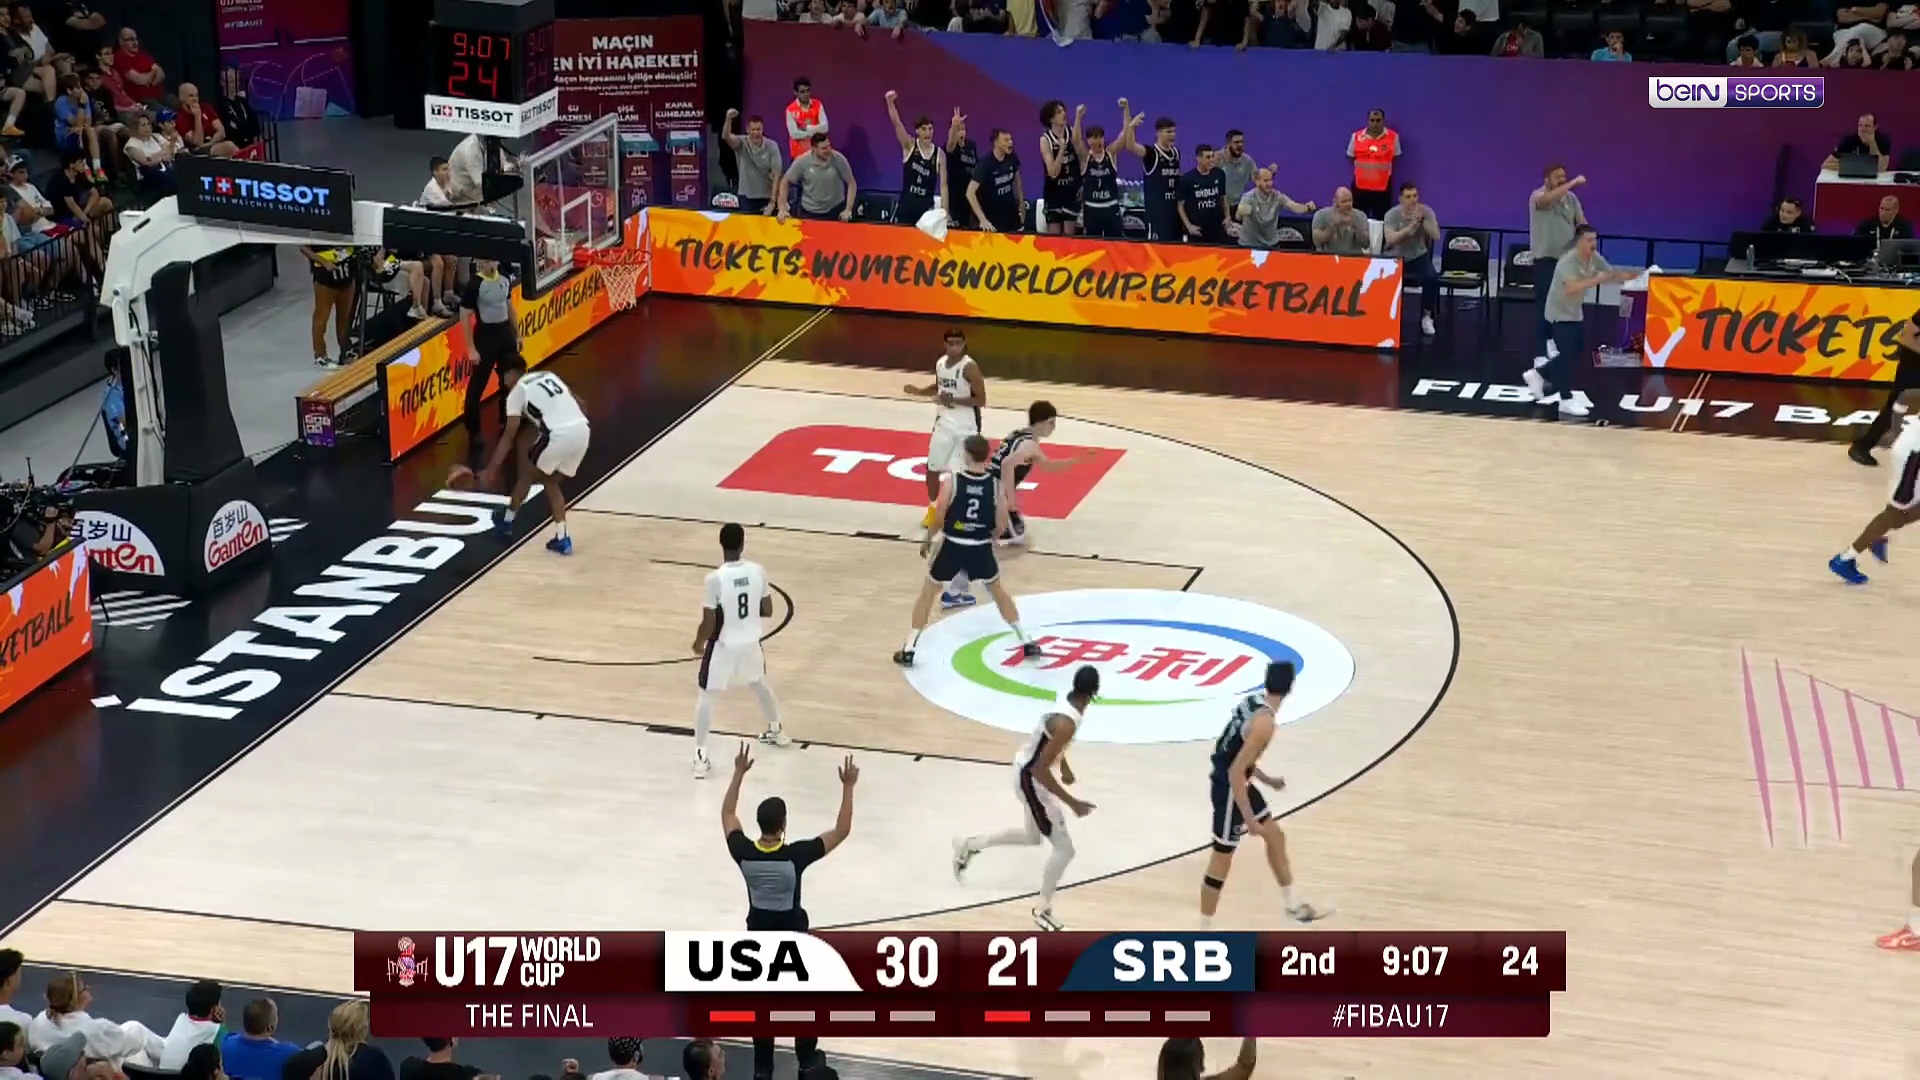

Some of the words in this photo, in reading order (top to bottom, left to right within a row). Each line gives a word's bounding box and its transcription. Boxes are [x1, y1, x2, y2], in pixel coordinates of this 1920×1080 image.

[453, 32, 510, 60] 9:07
[592, 35, 654, 51] MAÇIN
[578, 52, 602, 71] İYİ
[606, 50, 698, 69] HAREKETİ
[448, 61, 498, 98] 24
[455, 106, 514, 124] TISSOT
[532, 96, 556, 116] TISSOT
[231, 198, 274, 210] WATCHES
[235, 178, 330, 206] TISSOT
[537, 378, 564, 398] 13
[1619, 394, 1754, 418] U17
[966, 498, 979, 519] 2
[212, 504, 248, 539] 百岁山
[88, 543, 155, 574] nten
[737, 592, 749, 620] 8
[1000, 635, 1253, 687] 伊利
